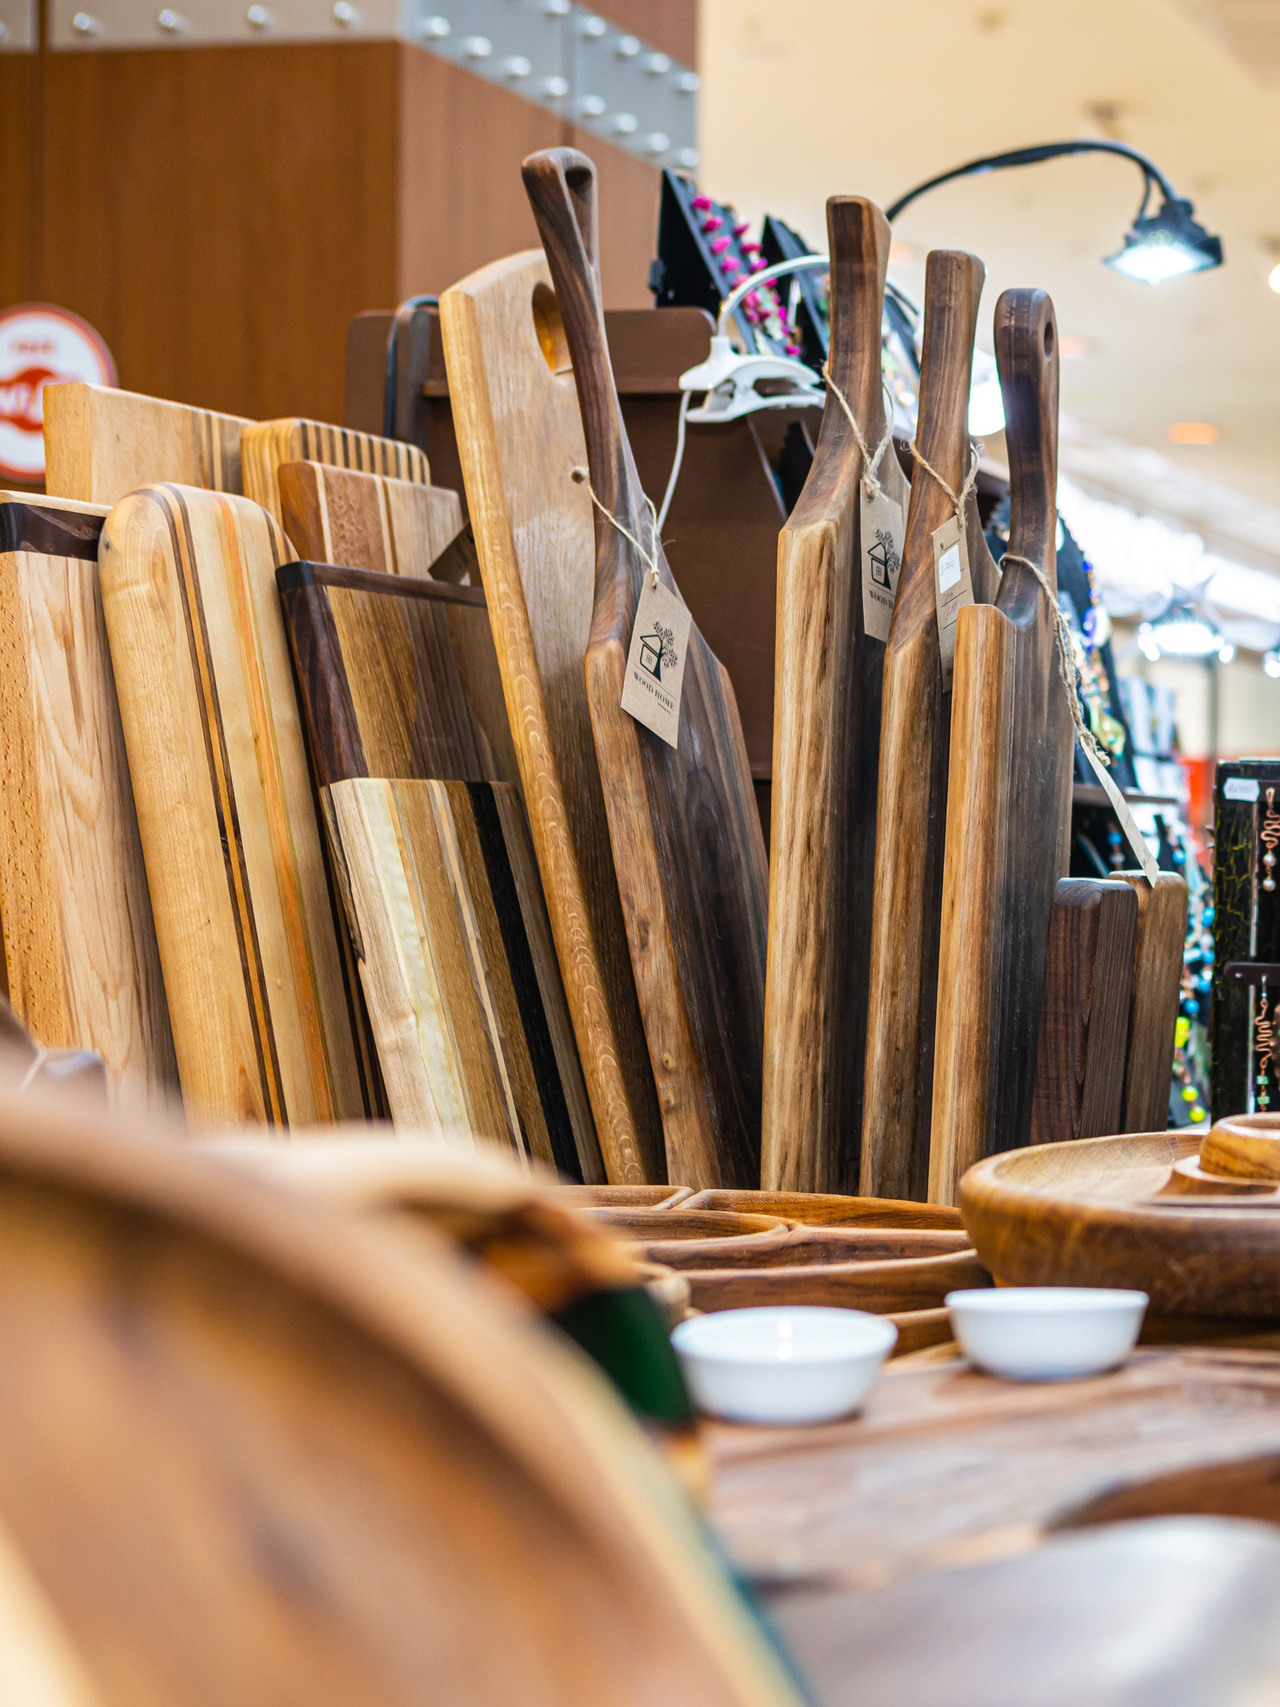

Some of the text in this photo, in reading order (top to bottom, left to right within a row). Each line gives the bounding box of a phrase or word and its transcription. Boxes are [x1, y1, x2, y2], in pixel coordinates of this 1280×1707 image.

[869, 590, 888, 606] WOOD
[633, 671, 675, 711] WOOD HOME
